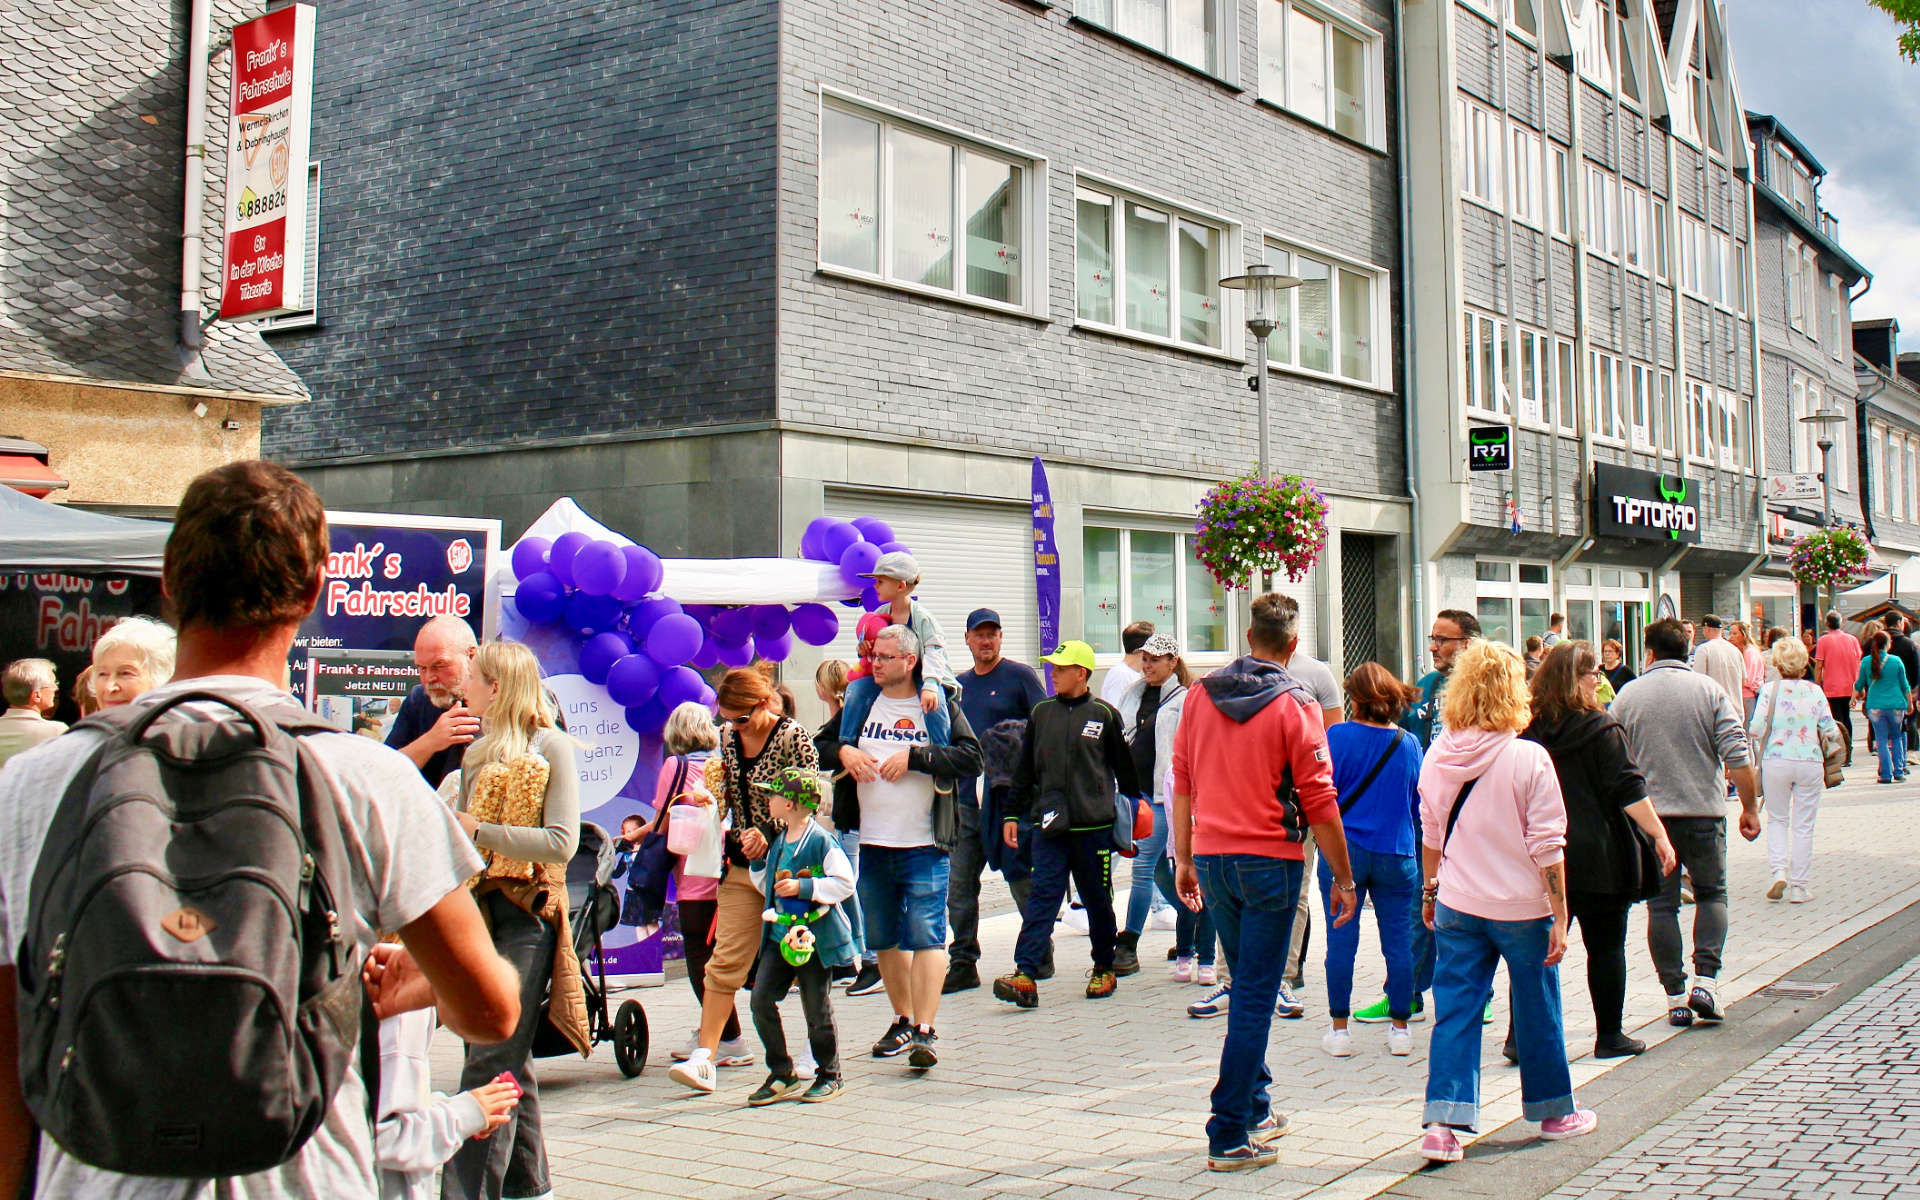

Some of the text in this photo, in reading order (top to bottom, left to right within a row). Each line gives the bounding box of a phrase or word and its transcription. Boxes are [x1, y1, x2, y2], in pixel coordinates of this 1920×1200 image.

[240, 66, 291, 103] Fahrschule
[247, 189, 286, 218] 888826
[240, 259, 256, 279] der
[257, 251, 283, 275] Woche
[240, 278, 273, 301] Theorie
[326, 580, 470, 617] Fahrschule
[311, 636, 343, 648] bieten:
[367, 665, 421, 677] Fahrschu
[345, 681, 371, 691] Jetzt
[372, 682, 395, 691] NEU
[569, 701, 599, 714] uns
[596, 719, 620, 735] die
[584, 745, 624, 763] ganz
[577, 764, 613, 782] aus!
